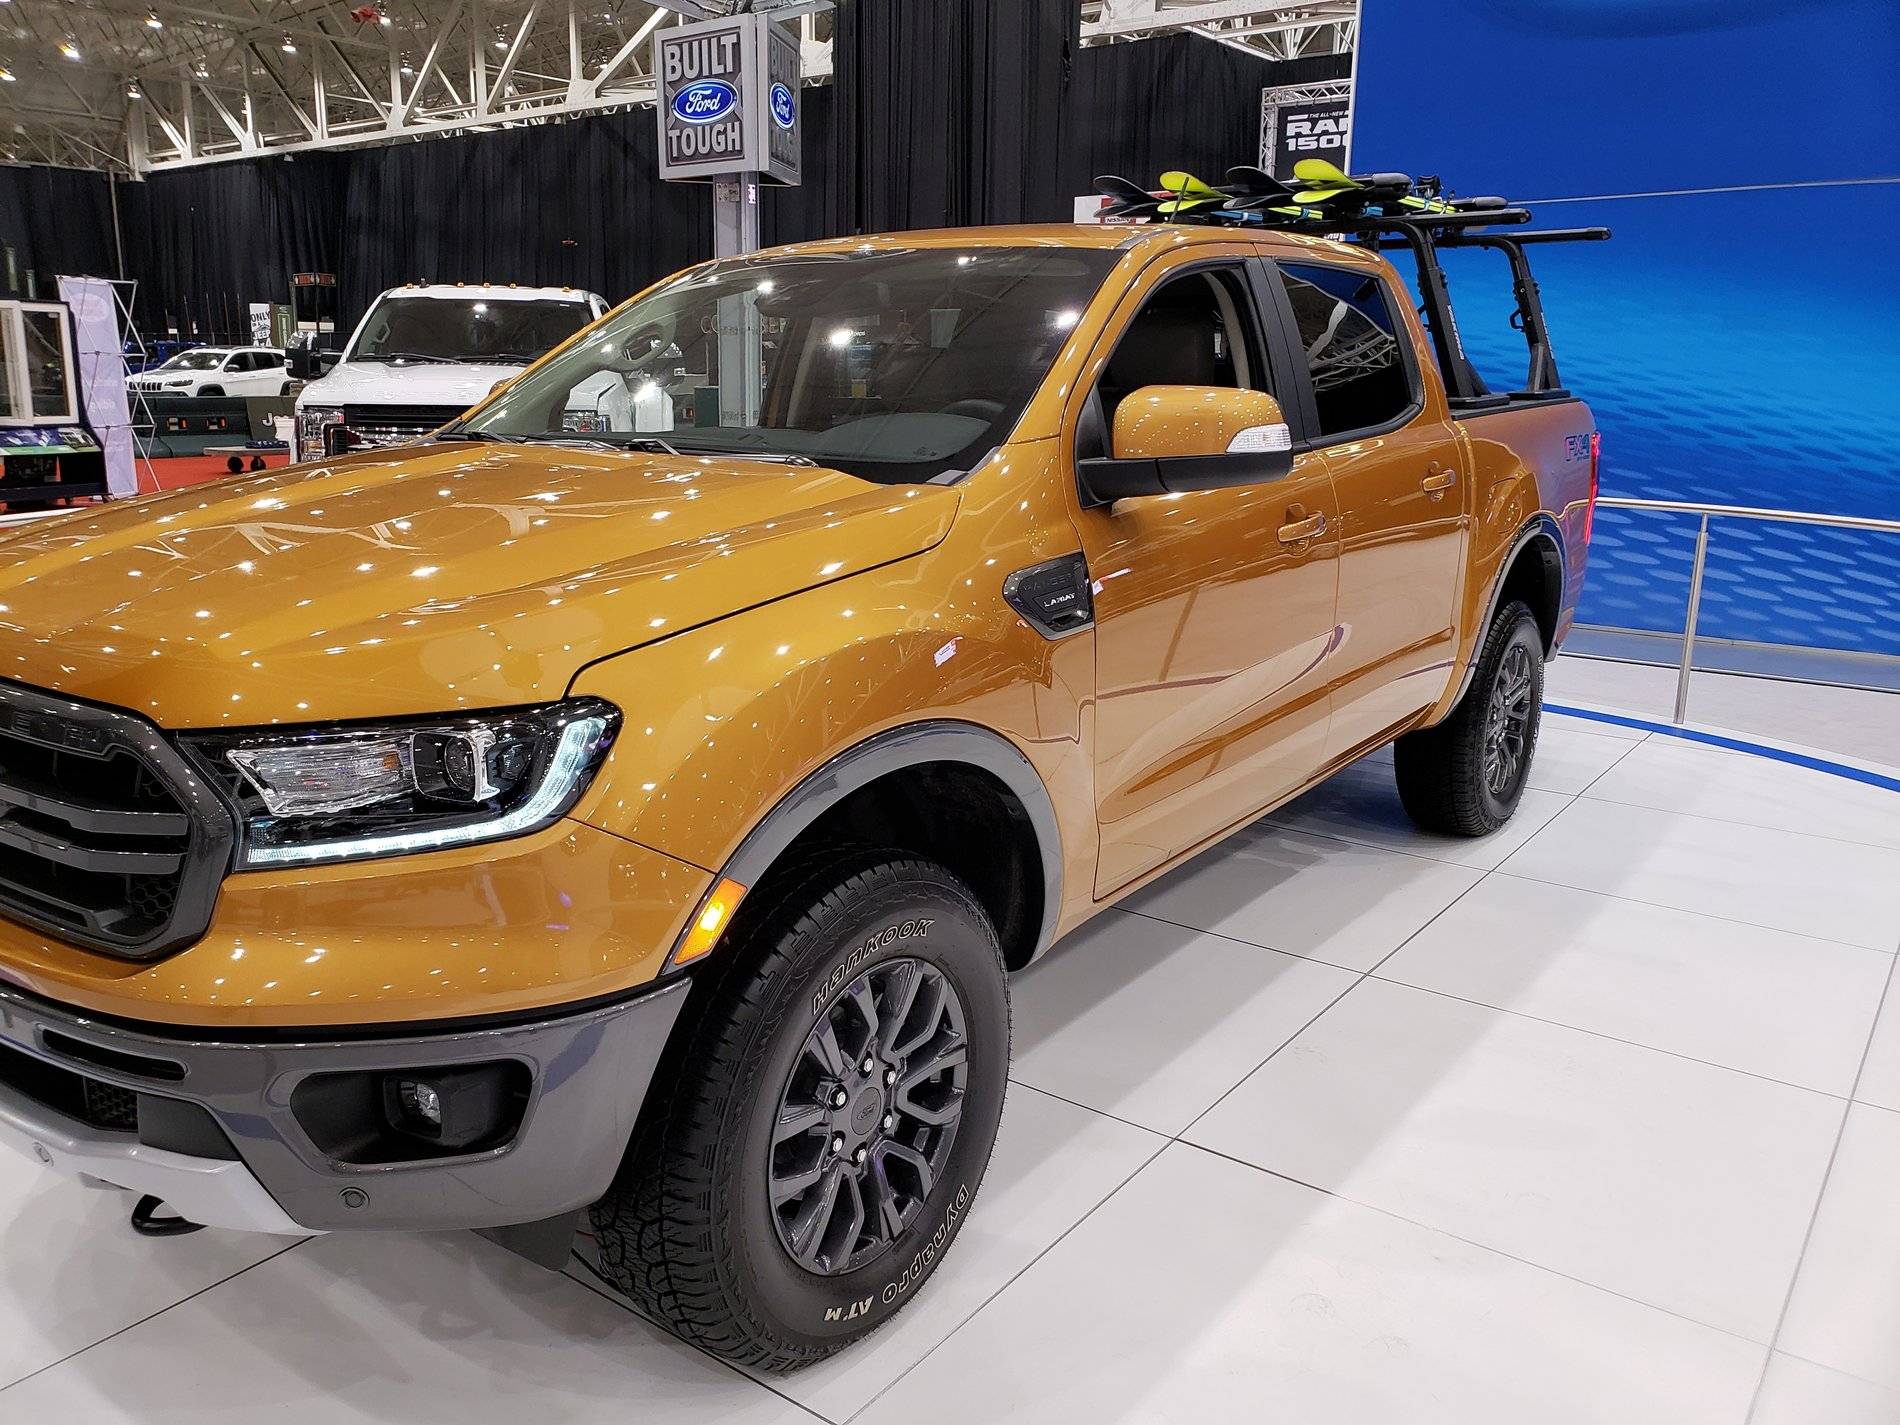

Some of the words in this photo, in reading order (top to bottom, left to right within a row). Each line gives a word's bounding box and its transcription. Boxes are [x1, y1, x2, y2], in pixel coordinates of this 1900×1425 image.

[666, 34, 738, 82] BUILT
[685, 89, 721, 114] Ford
[668, 121, 741, 158] TOUGH
[251, 311, 270, 322] ONLY
[252, 330, 270, 340] JEEP
